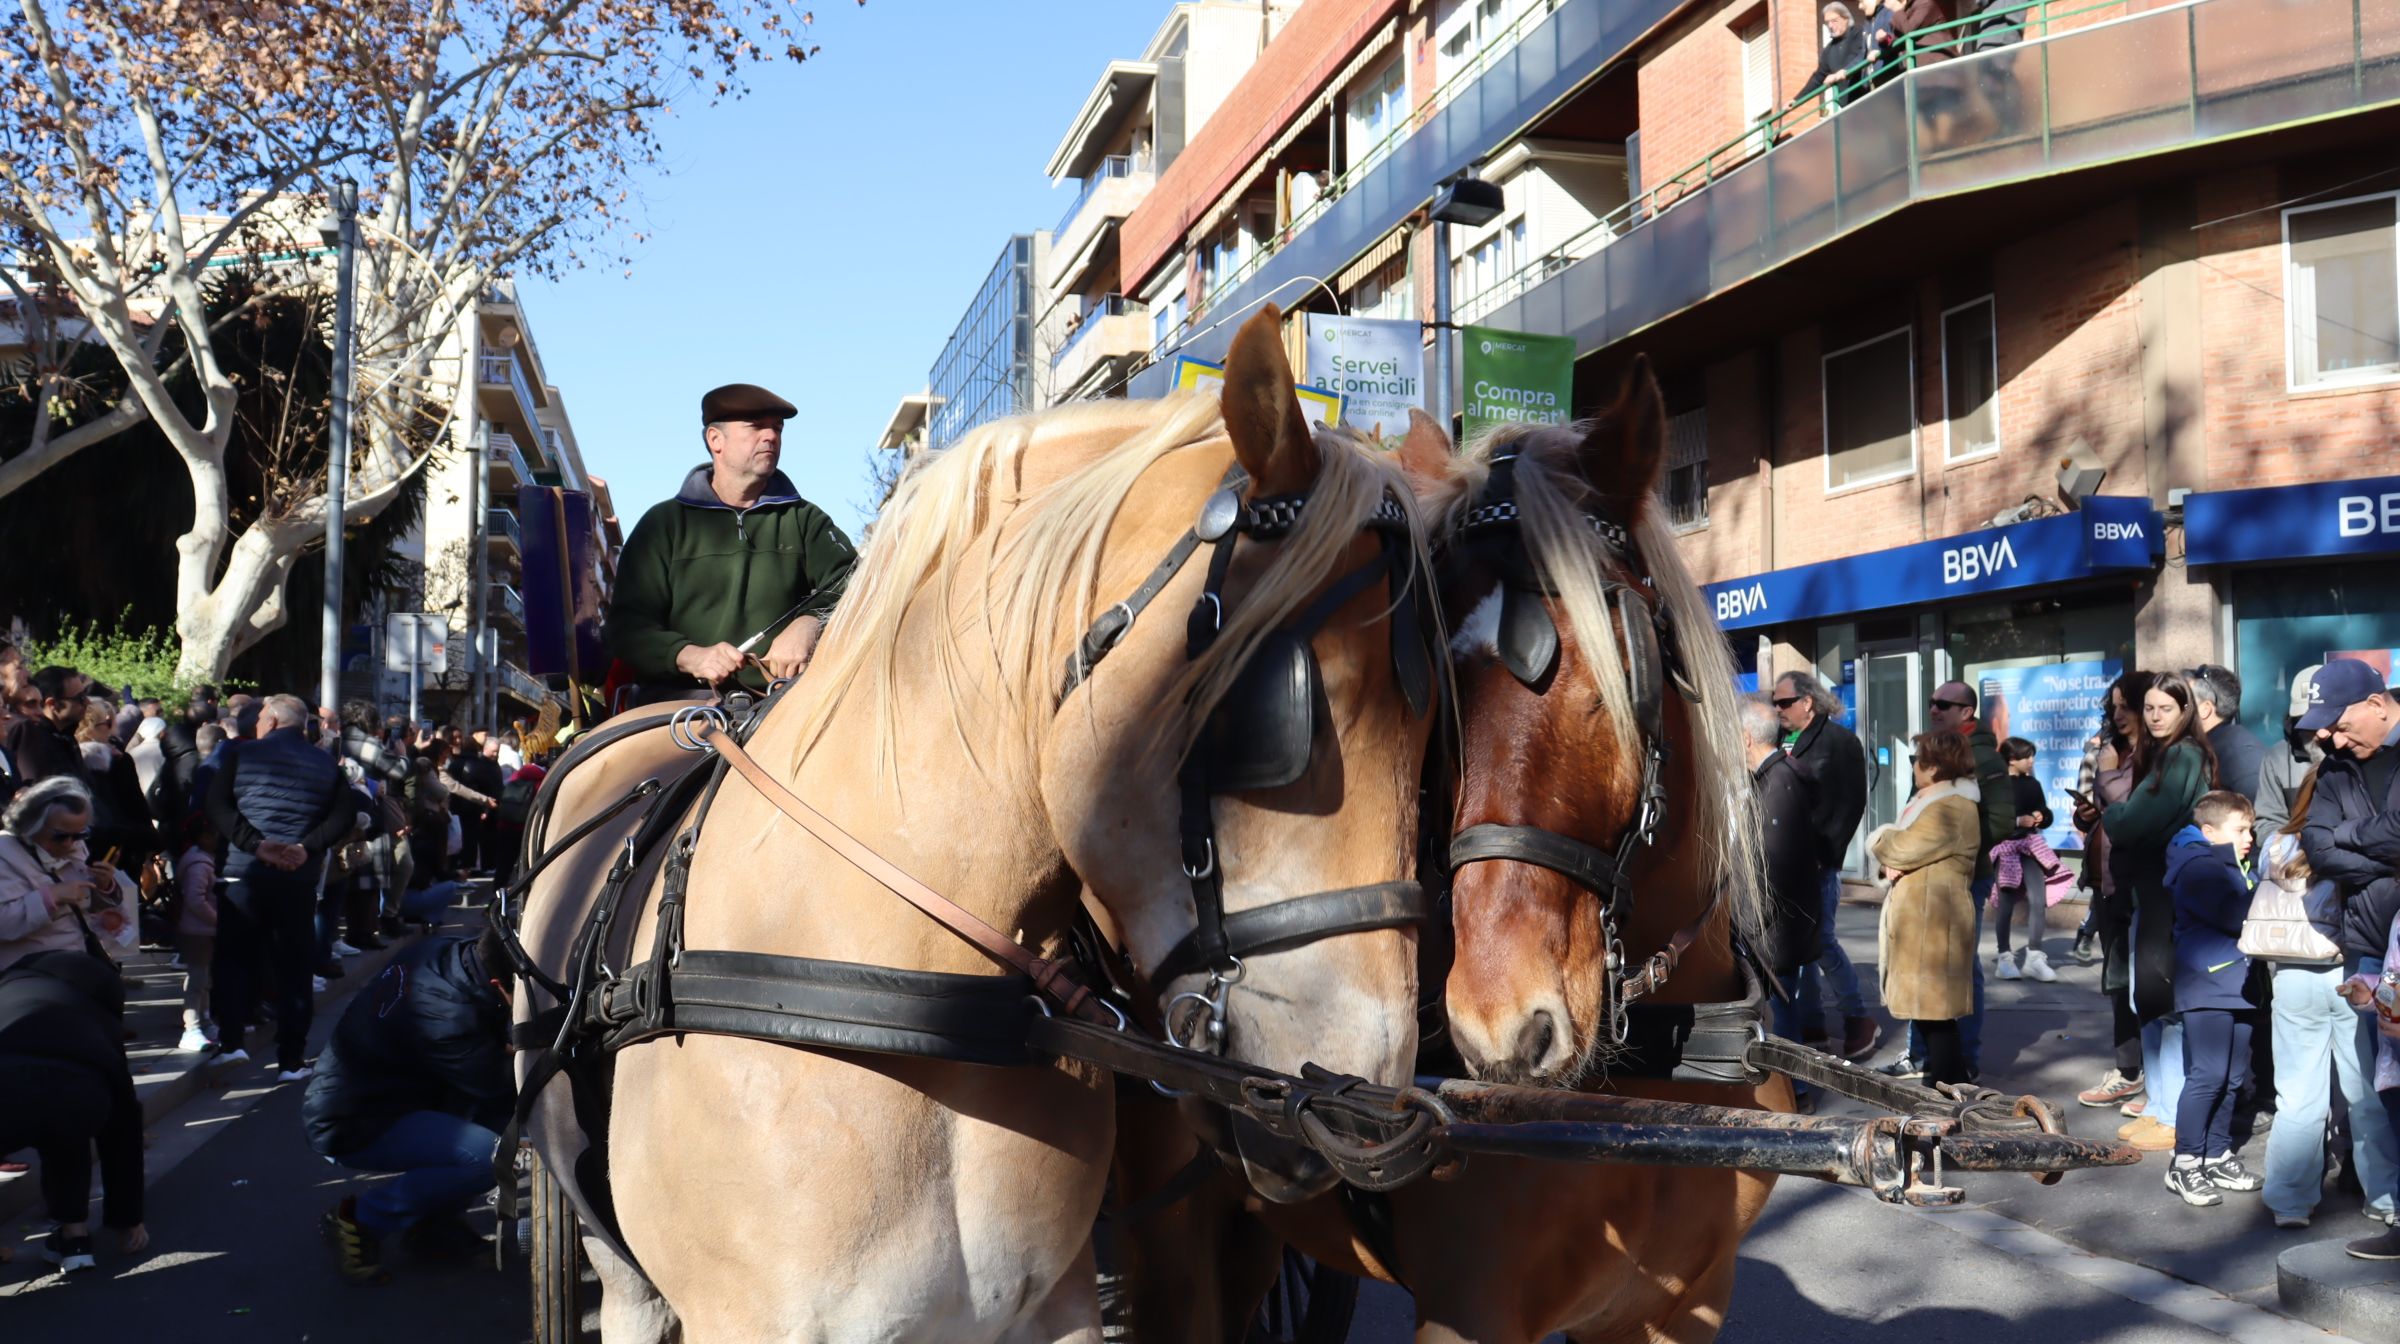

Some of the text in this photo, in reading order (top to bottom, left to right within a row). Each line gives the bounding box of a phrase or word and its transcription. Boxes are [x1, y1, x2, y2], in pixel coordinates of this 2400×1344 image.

[1495, 342, 1526, 352] MERCAT
[1331, 355, 1397, 375] Servei
[1315, 375, 1415, 396] a domicili
[1474, 380, 1556, 407] Compra
[1368, 407, 1395, 417] online
[1468, 399, 1482, 417] al
[2338, 493, 2400, 537] BB
[2094, 522, 2144, 540] BBVA
[1943, 535, 2018, 584] BBVA
[1716, 581, 1768, 620] BBVA
[2068, 677, 2081, 691] se
[2017, 695, 2032, 713] de
[2033, 693, 2090, 716] competir
[2021, 716, 2053, 732] otros
[2034, 737, 2048, 751] se
[2049, 735, 2080, 751] trata
[2047, 791, 2060, 810] lo
